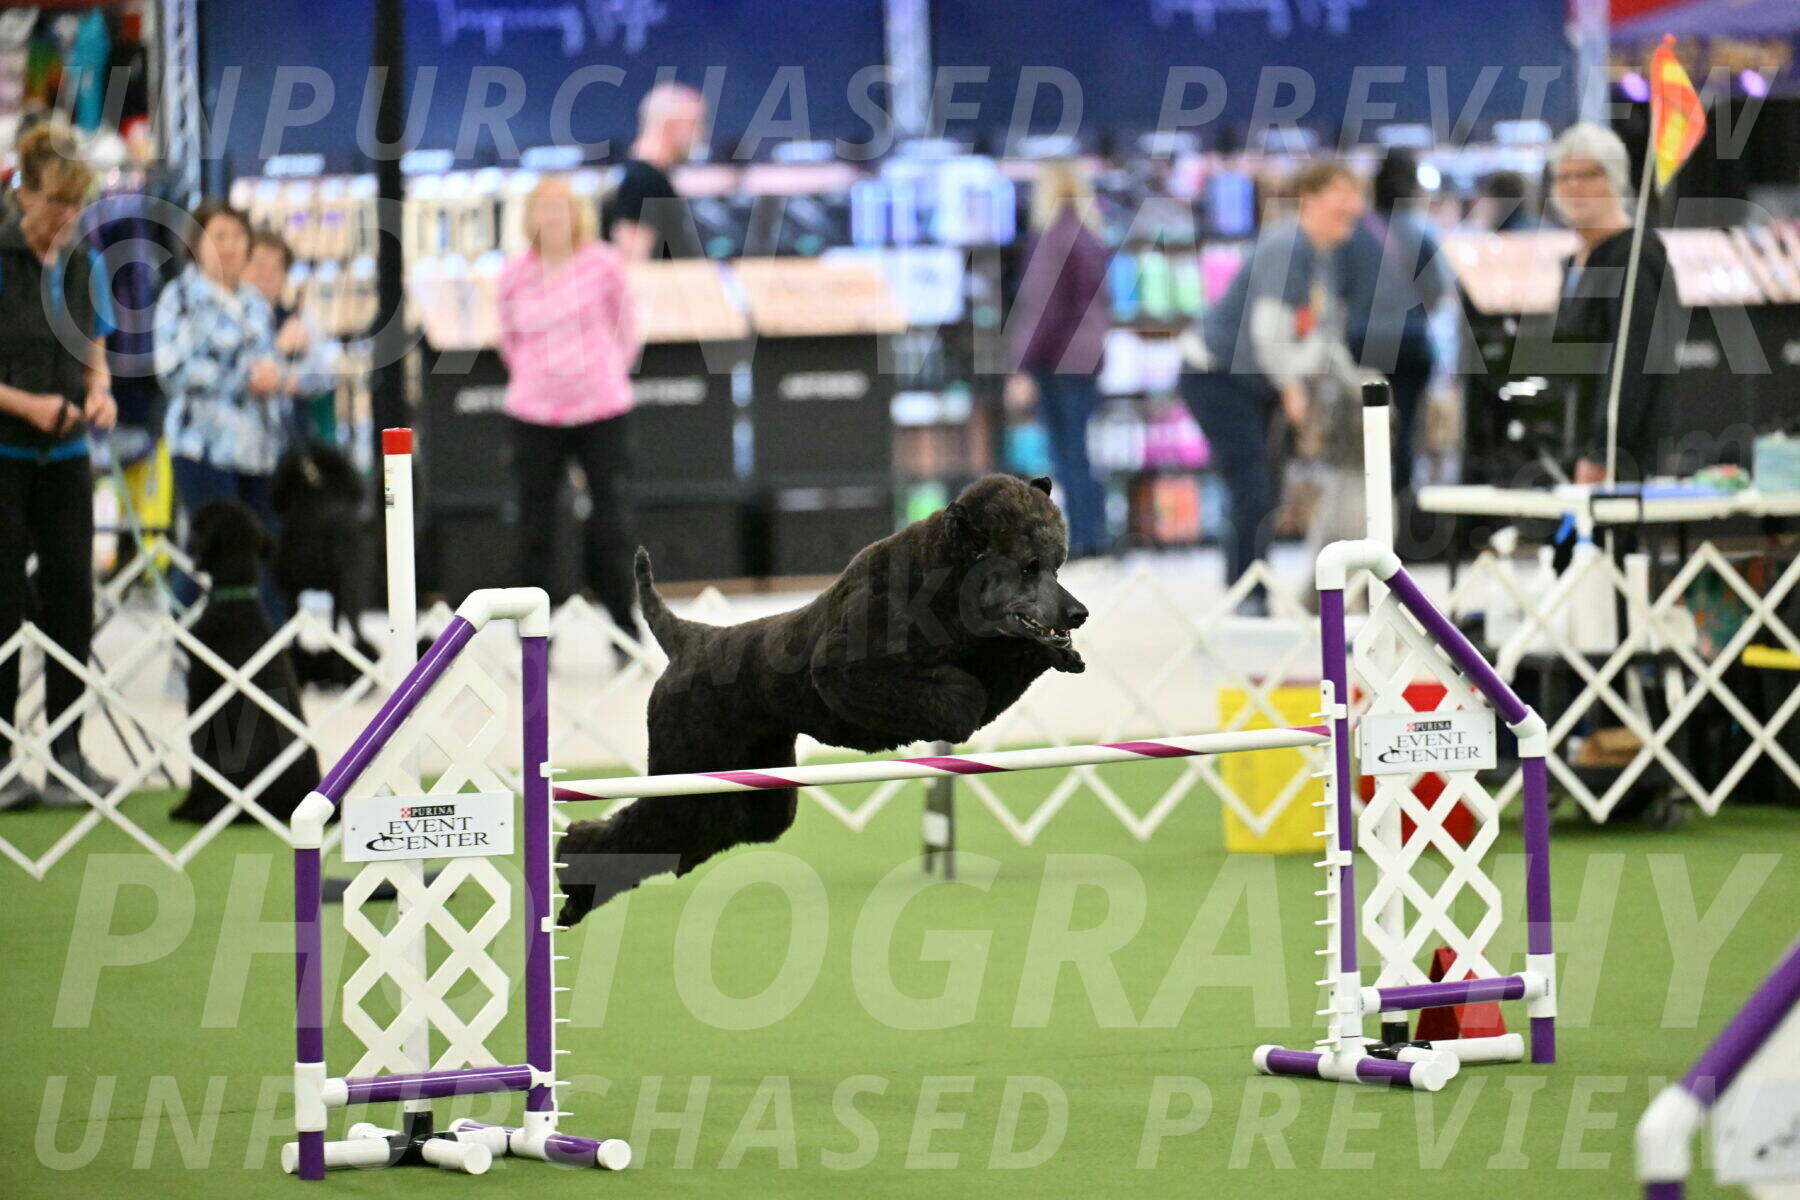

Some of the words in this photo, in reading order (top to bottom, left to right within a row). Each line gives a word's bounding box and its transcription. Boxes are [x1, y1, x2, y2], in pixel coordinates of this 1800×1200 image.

[1415, 721, 1451, 731] PURINA
[1397, 732, 1466, 748] EVENT
[1377, 746, 1481, 763] CENTER
[411, 805, 454, 817] PURINA
[388, 817, 472, 835] EVENT
[366, 832, 490, 851] CENTER
